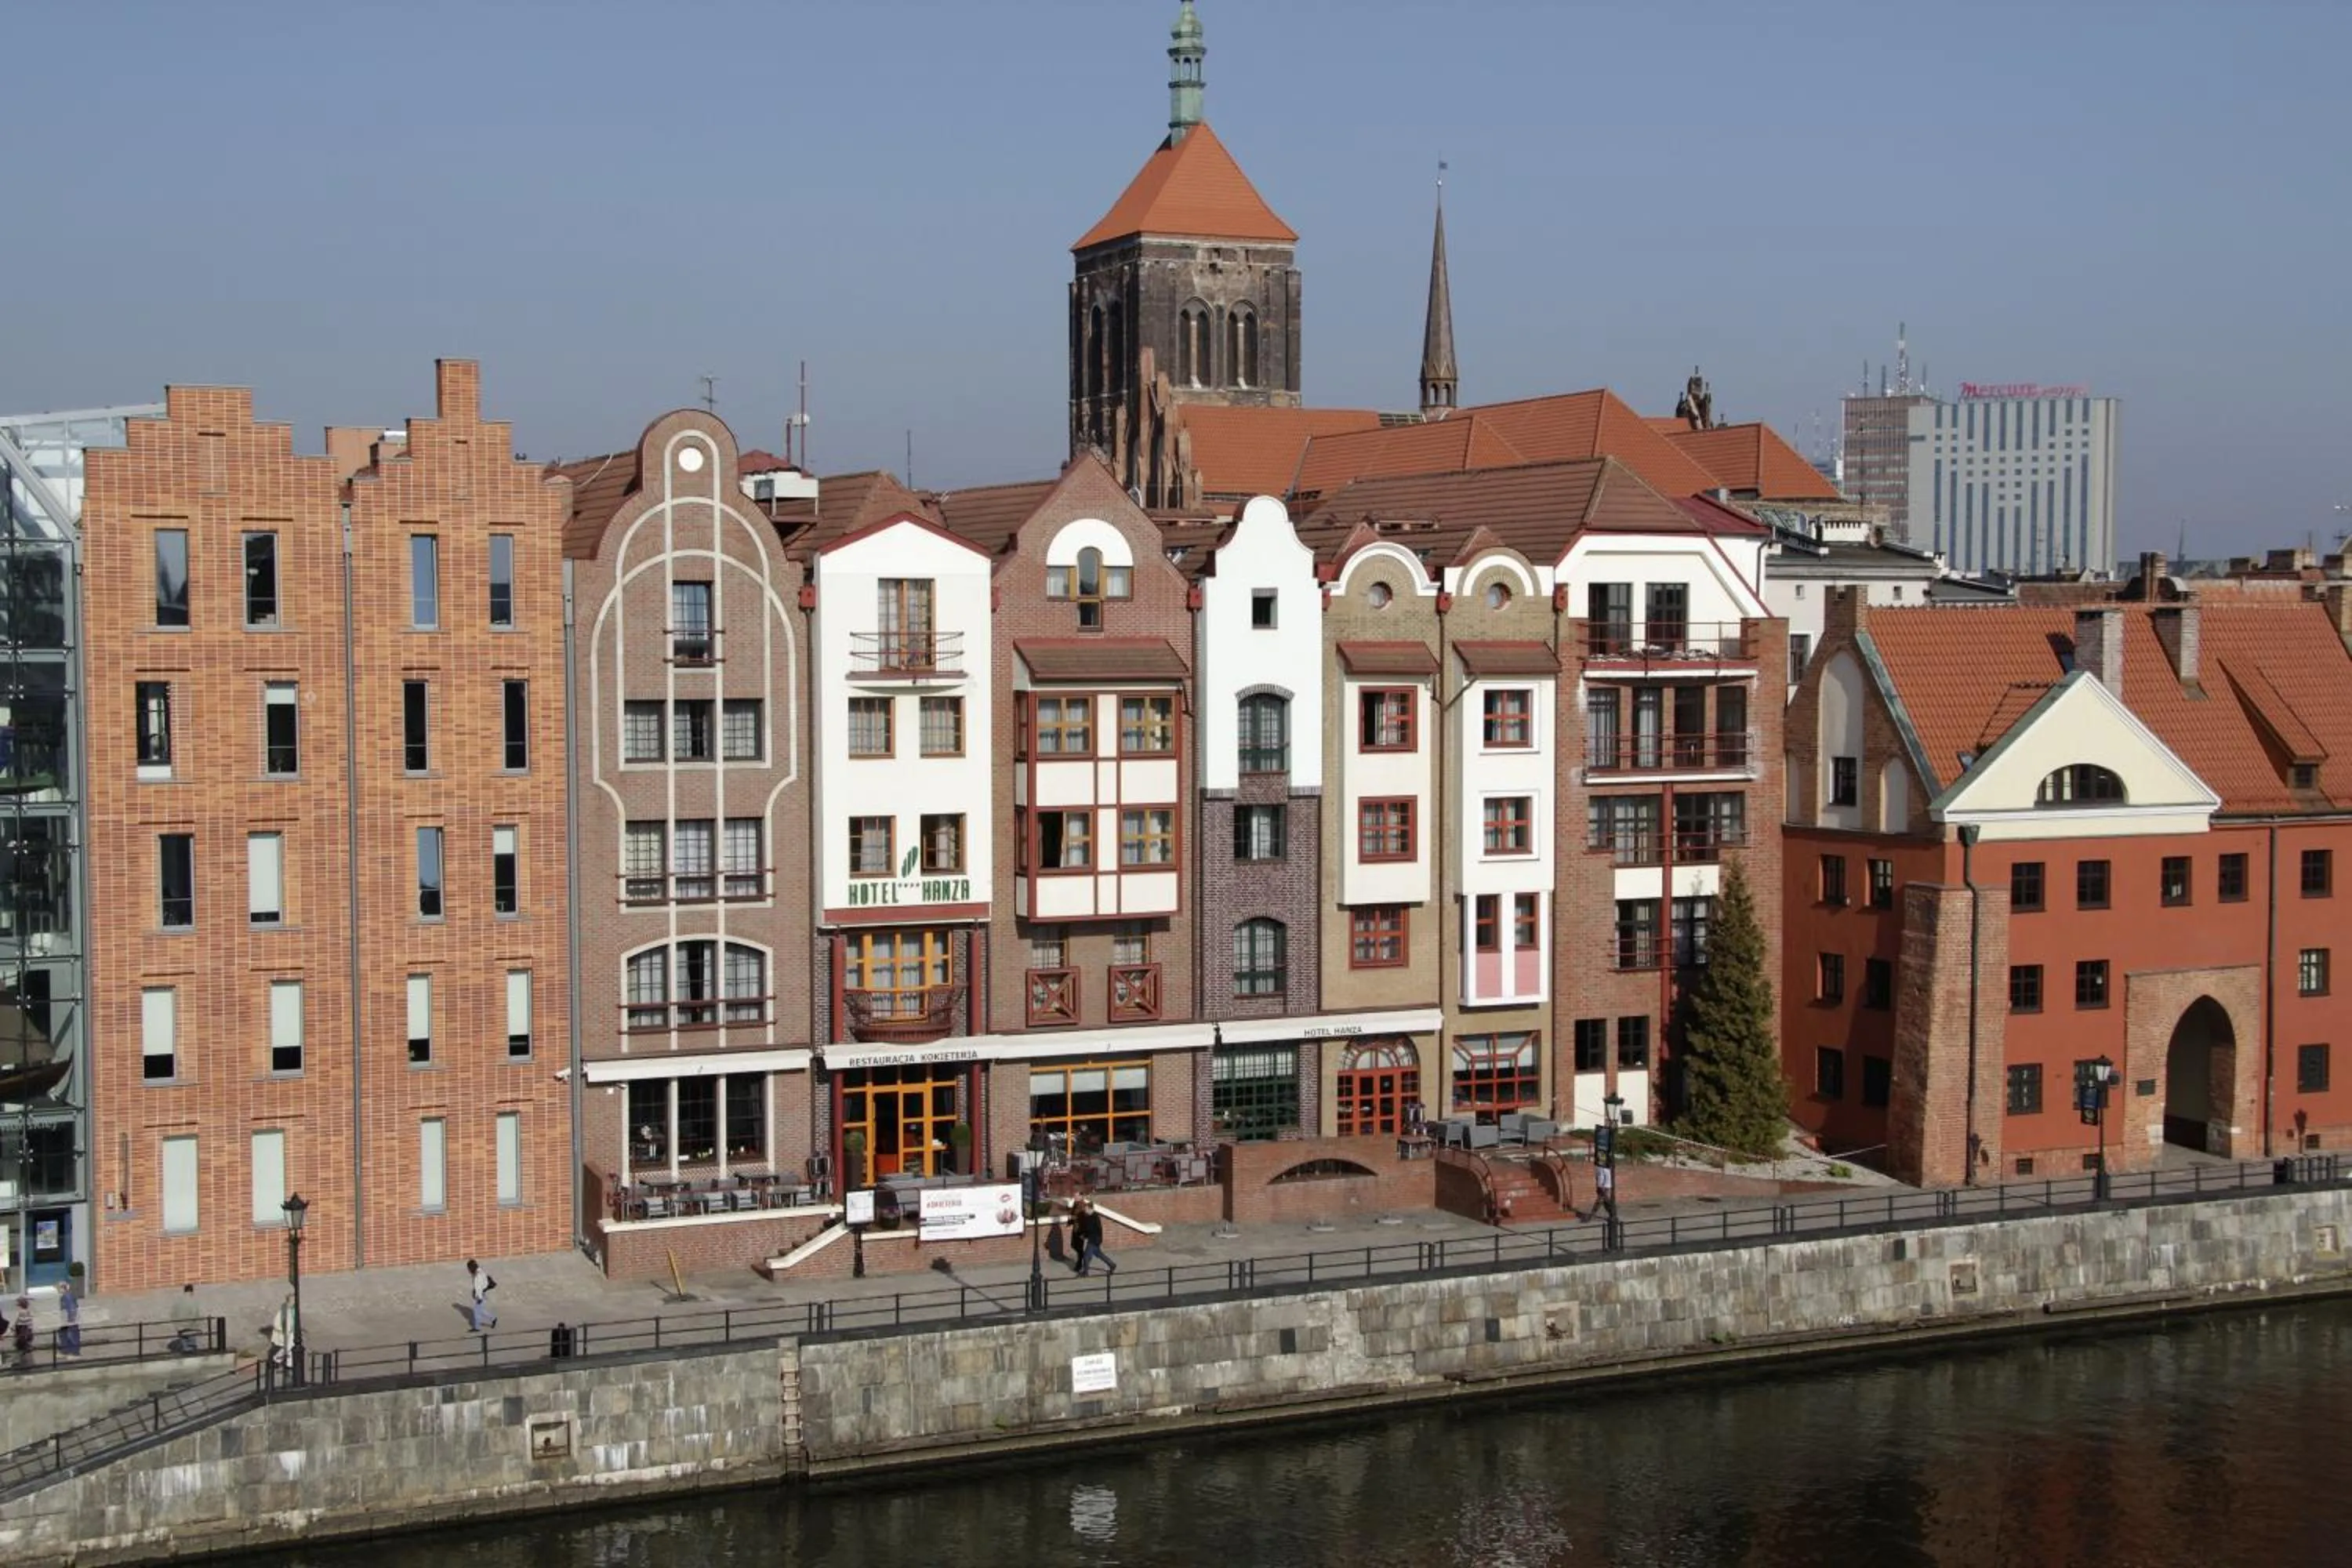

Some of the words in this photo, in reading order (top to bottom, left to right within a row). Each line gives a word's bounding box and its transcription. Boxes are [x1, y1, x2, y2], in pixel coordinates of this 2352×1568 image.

[848, 882, 899, 906] HOTEL
[922, 879, 971, 902] HANZA
[1304, 1028, 1332, 1037] HOTEL
[1334, 1025, 1362, 1035] HANZA
[849, 1054, 915, 1067] RESTAURACJA
[920, 1050, 978, 1062] KOKIETERIA
